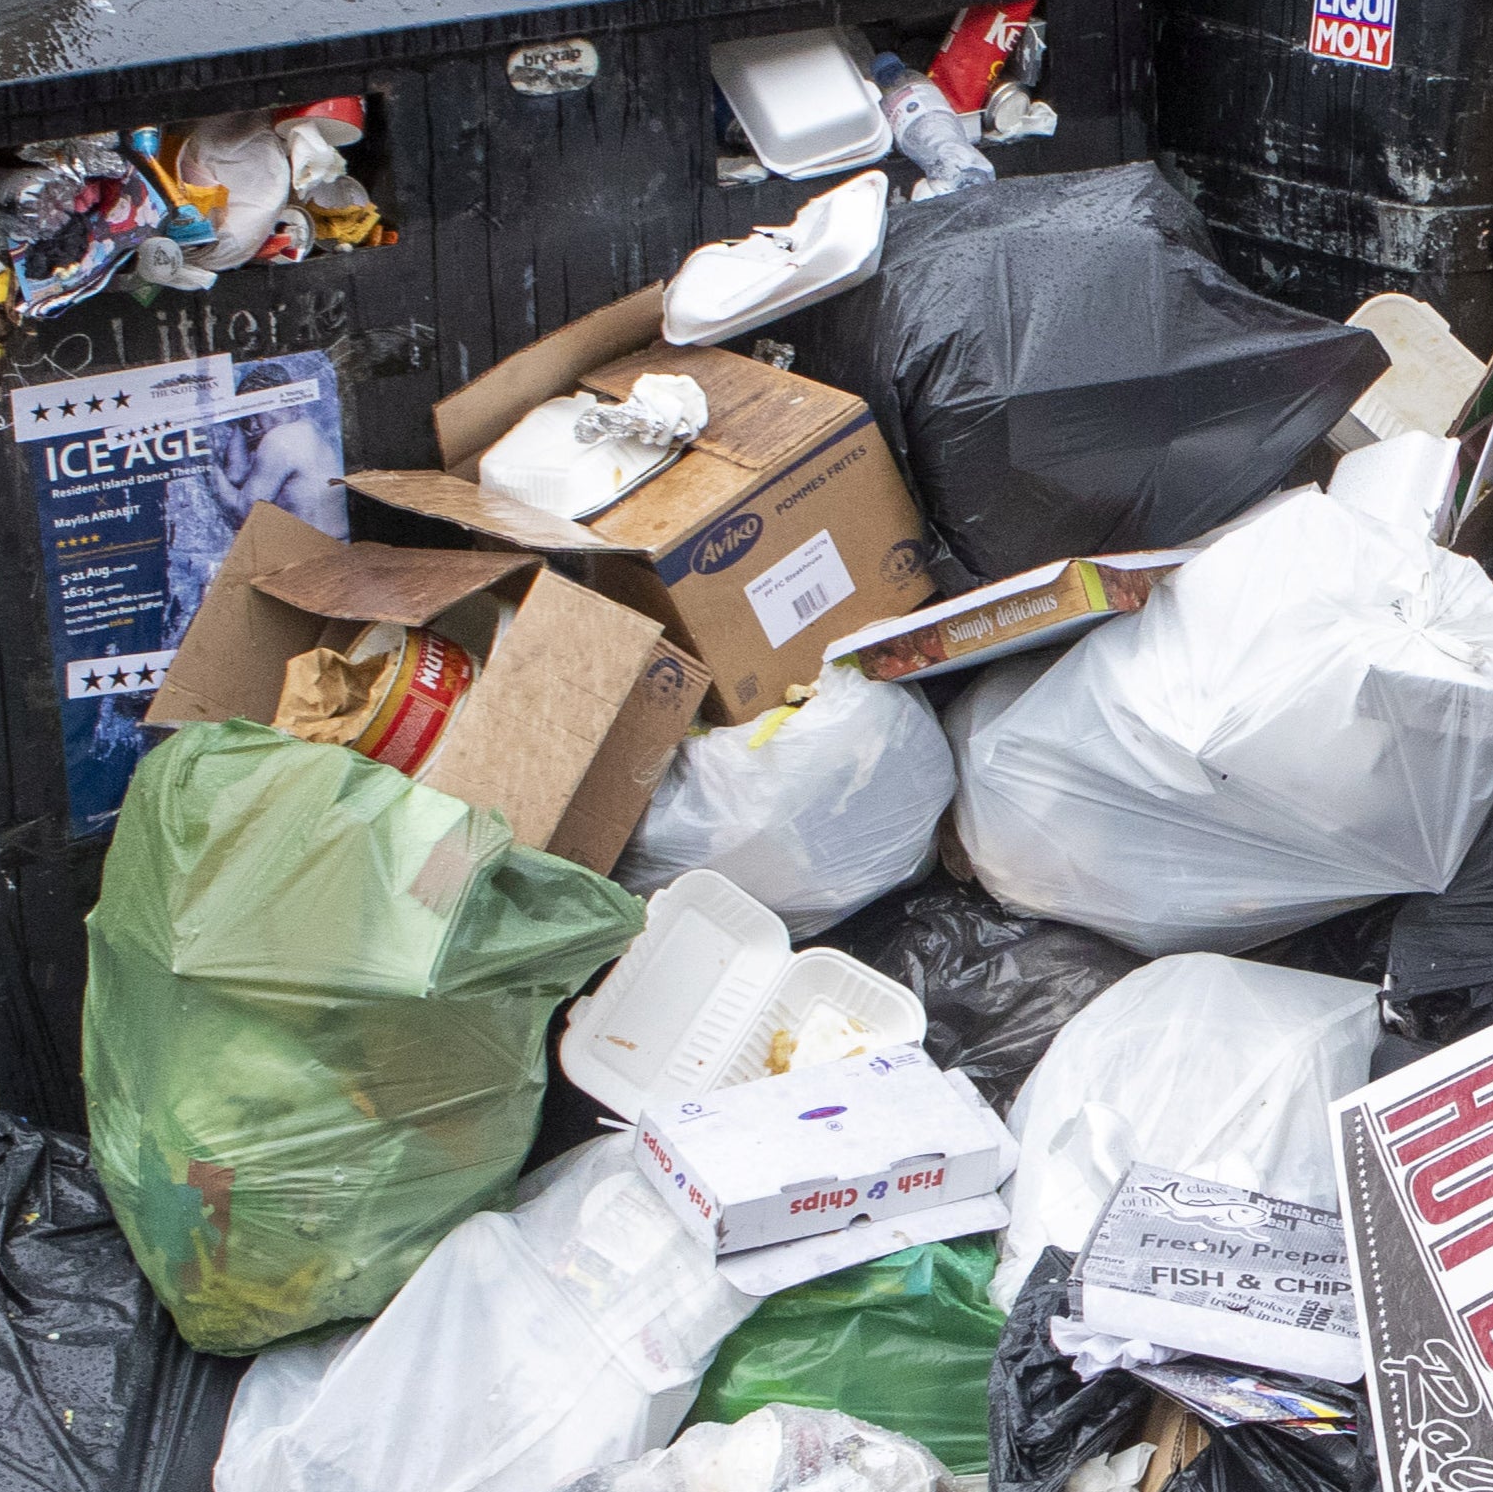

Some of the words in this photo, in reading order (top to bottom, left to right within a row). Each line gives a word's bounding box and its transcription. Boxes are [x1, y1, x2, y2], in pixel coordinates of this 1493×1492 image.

[1314, 18, 1391, 63] MOLY
[45, 441, 116, 483] ICE
[123, 429, 212, 470] AGE
[52, 484, 100, 499] Resident
[102, 477, 135, 493] Island
[137, 470, 170, 485] Dance
[171, 463, 213, 479] Theatre
[774, 470, 827, 516] POMMES
[826, 444, 868, 478] FRITES
[54, 513, 91, 530] Maylis
[947, 612, 994, 644] Simply
[996, 593, 1058, 628] delicious
[642, 1130, 674, 1175] Chips
[867, 1179, 889, 1200] &
[897, 1167, 945, 1194] Fish
[789, 1187, 859, 1215] Chips
[1140, 1233, 1249, 1258] Freshly
[1151, 1266, 1225, 1288] FISH
[1236, 1273, 1262, 1291] &
[1273, 1277, 1356, 1298] CHIP
